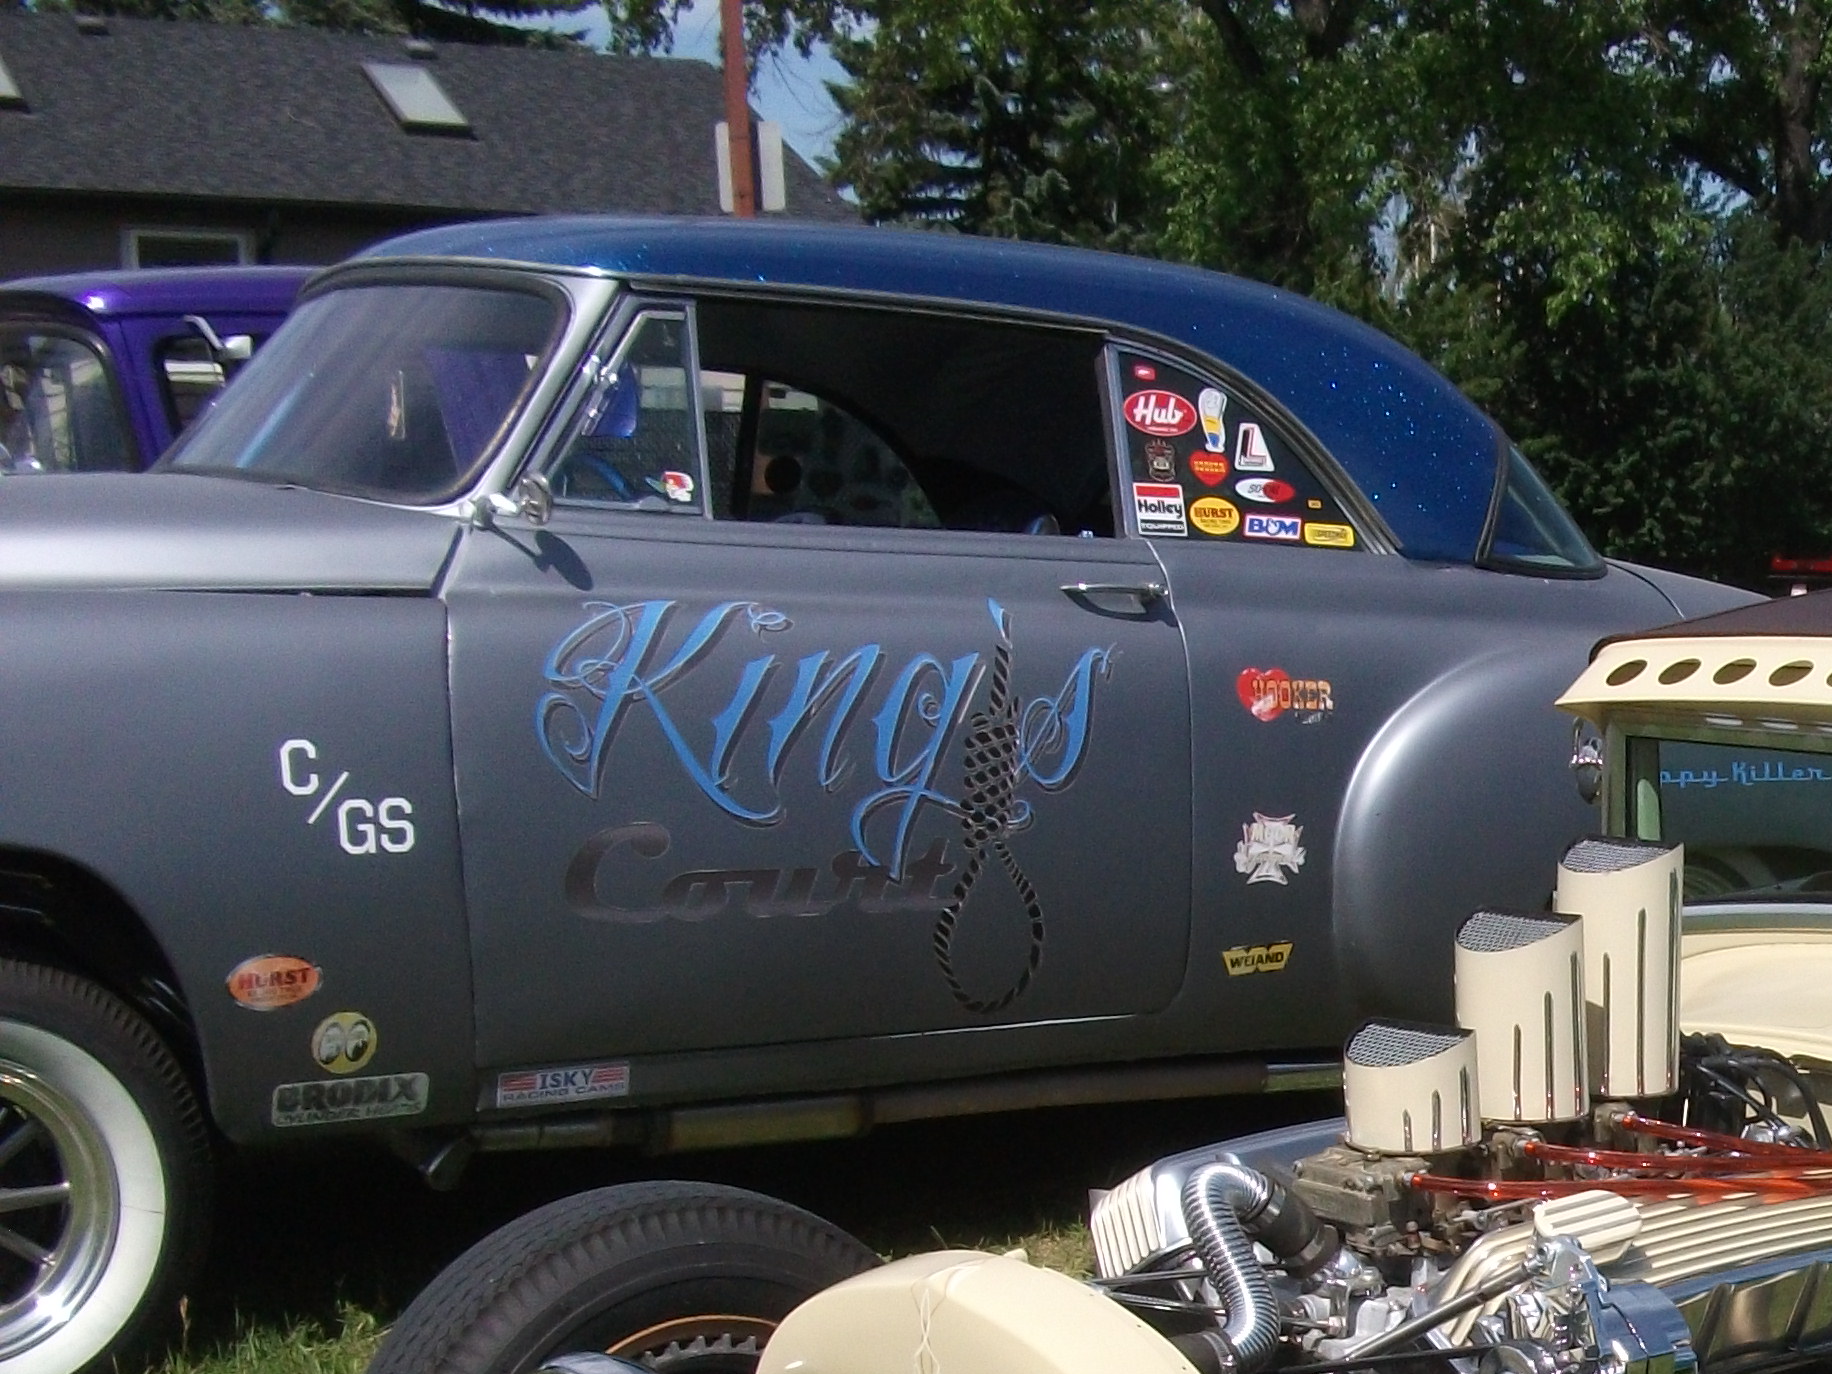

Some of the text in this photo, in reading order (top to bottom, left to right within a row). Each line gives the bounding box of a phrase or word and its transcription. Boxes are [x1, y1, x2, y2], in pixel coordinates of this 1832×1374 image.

[1133, 394, 1183, 425] Hub
[1137, 499, 1183, 519] Holley
[1252, 680, 1334, 710] HOOKER
[1732, 761, 1832, 786] Killer
[539, 1069, 594, 1090] ISKY
